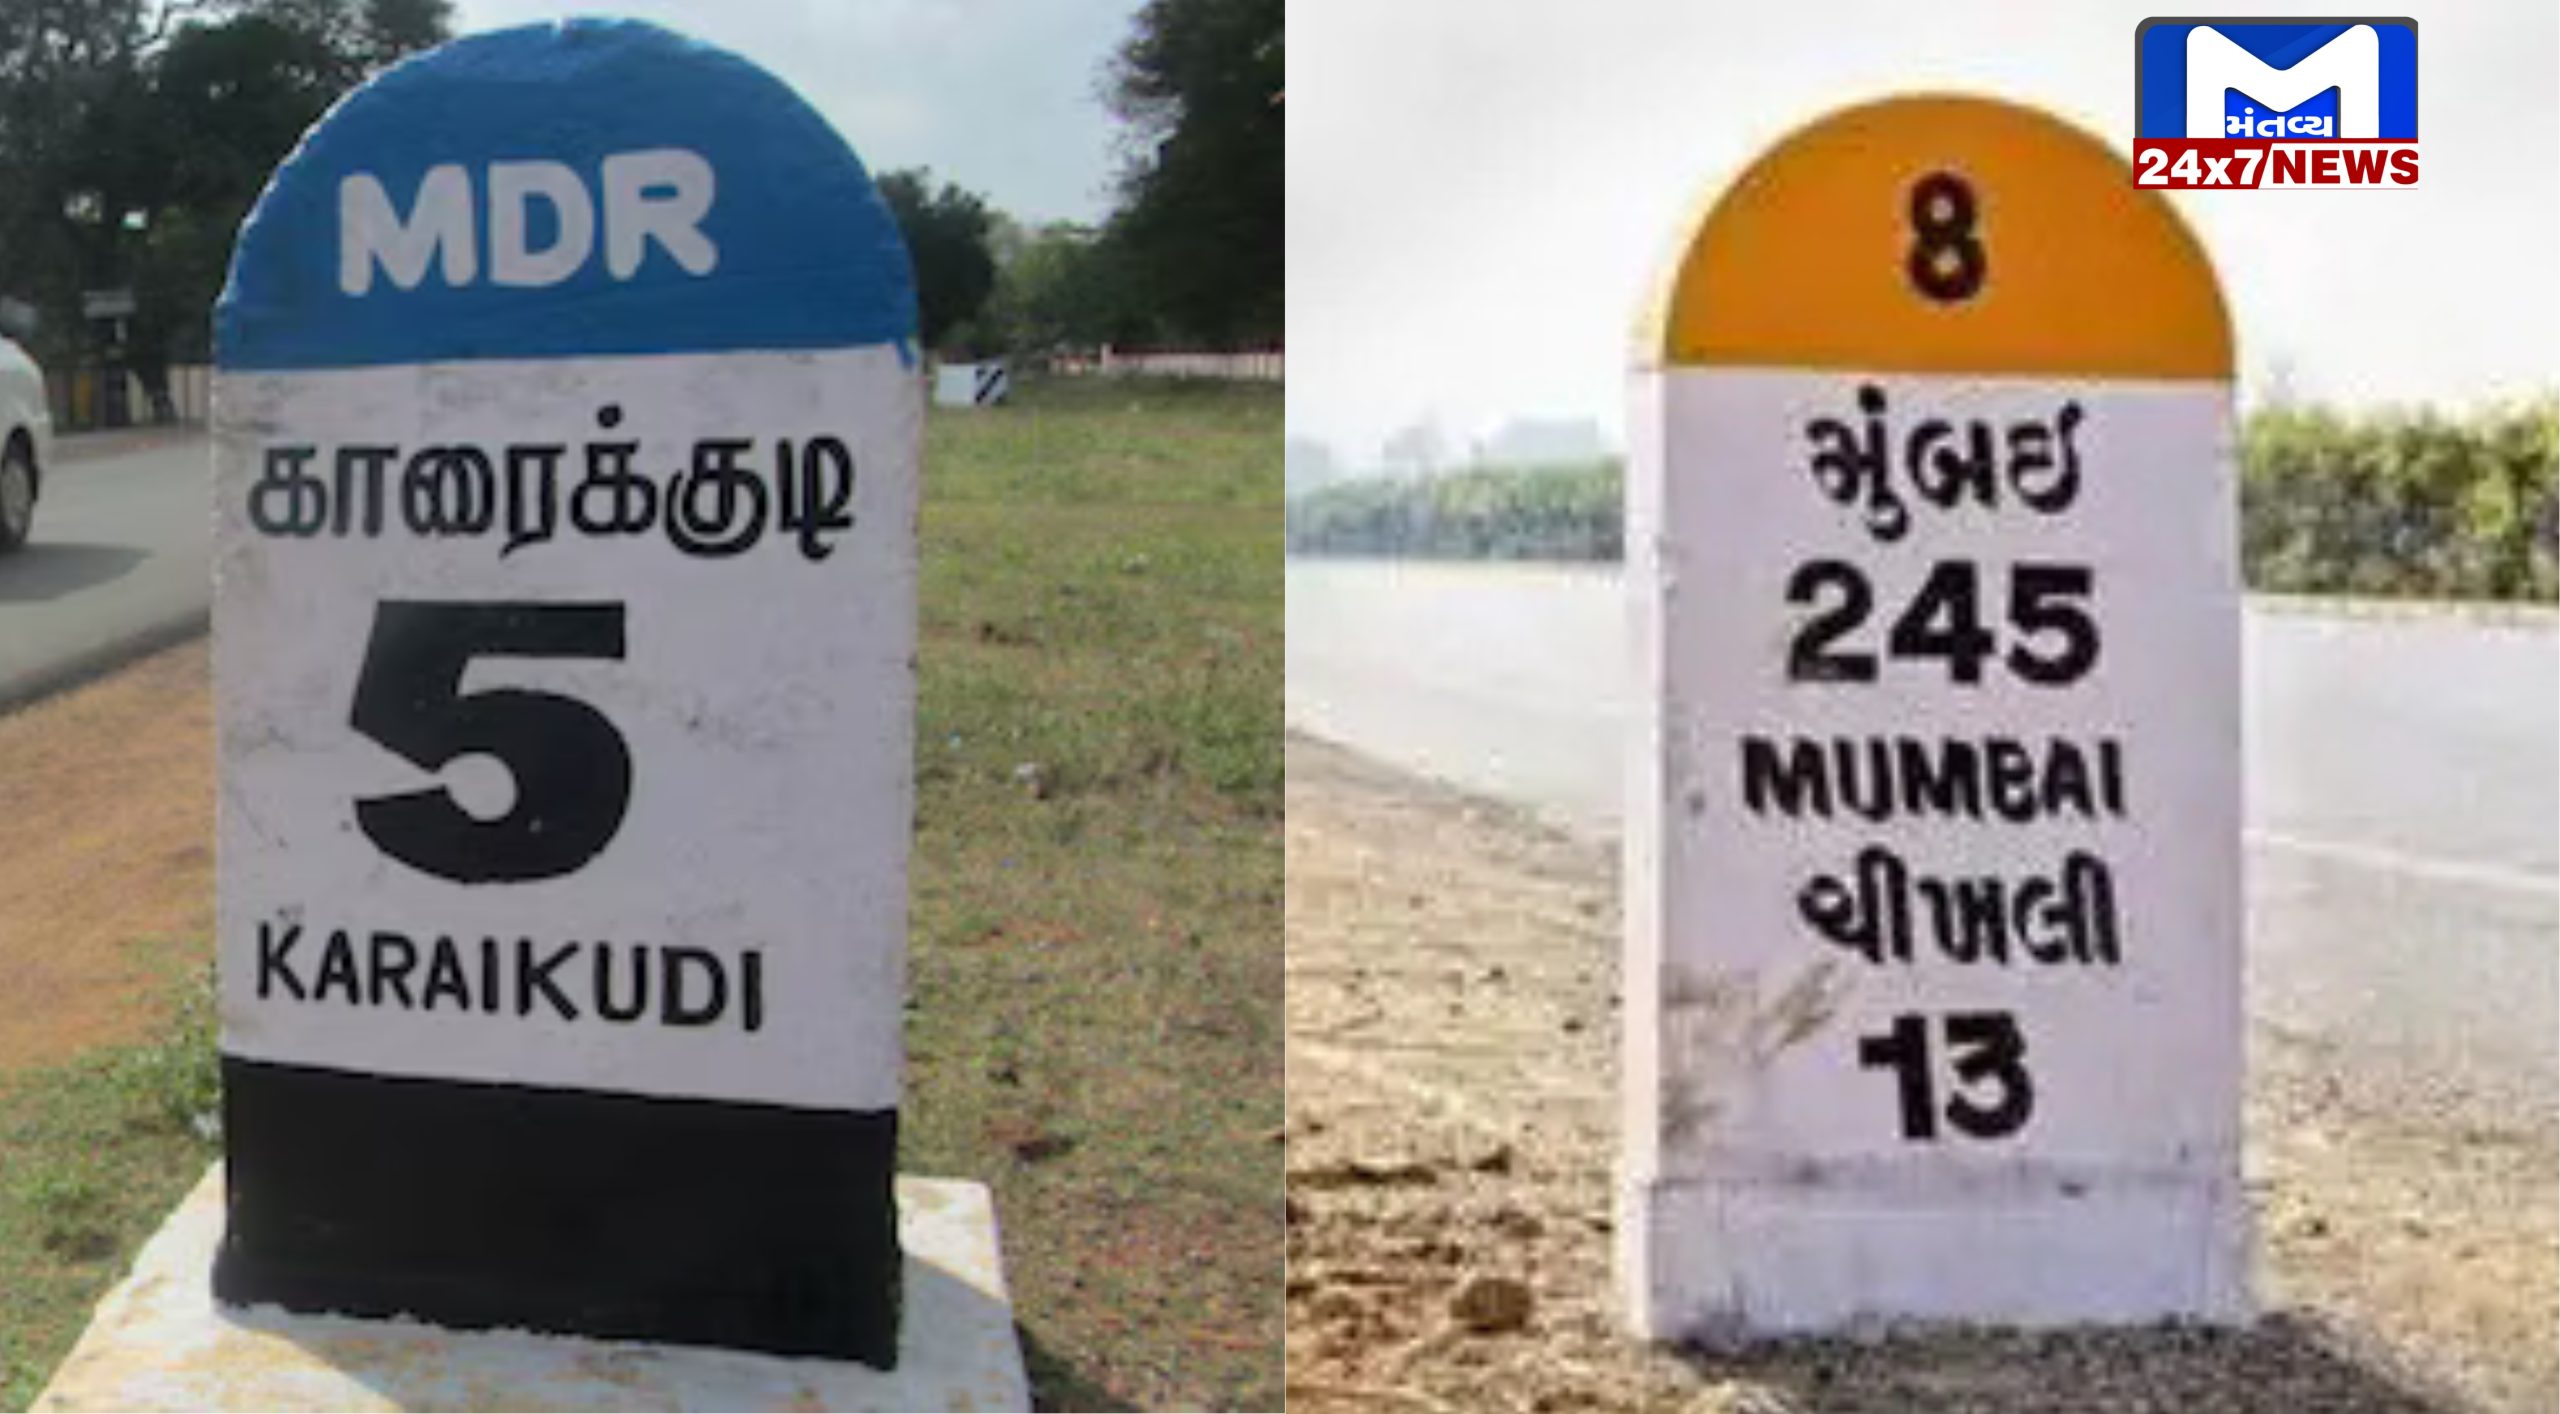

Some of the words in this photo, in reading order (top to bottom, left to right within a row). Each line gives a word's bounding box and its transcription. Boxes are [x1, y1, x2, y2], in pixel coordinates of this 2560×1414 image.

[339, 148, 719, 297] MDR
[1909, 170, 1987, 305] 8
[248, 405, 853, 561] காரைக்குடி
[1785, 560, 2098, 685] 245
[350, 600, 633, 885] 5
[1740, 735, 2126, 821] MUMBAI
[256, 921, 763, 1033] KARAIKUDI
[1858, 1010, 2035, 1139] 13
